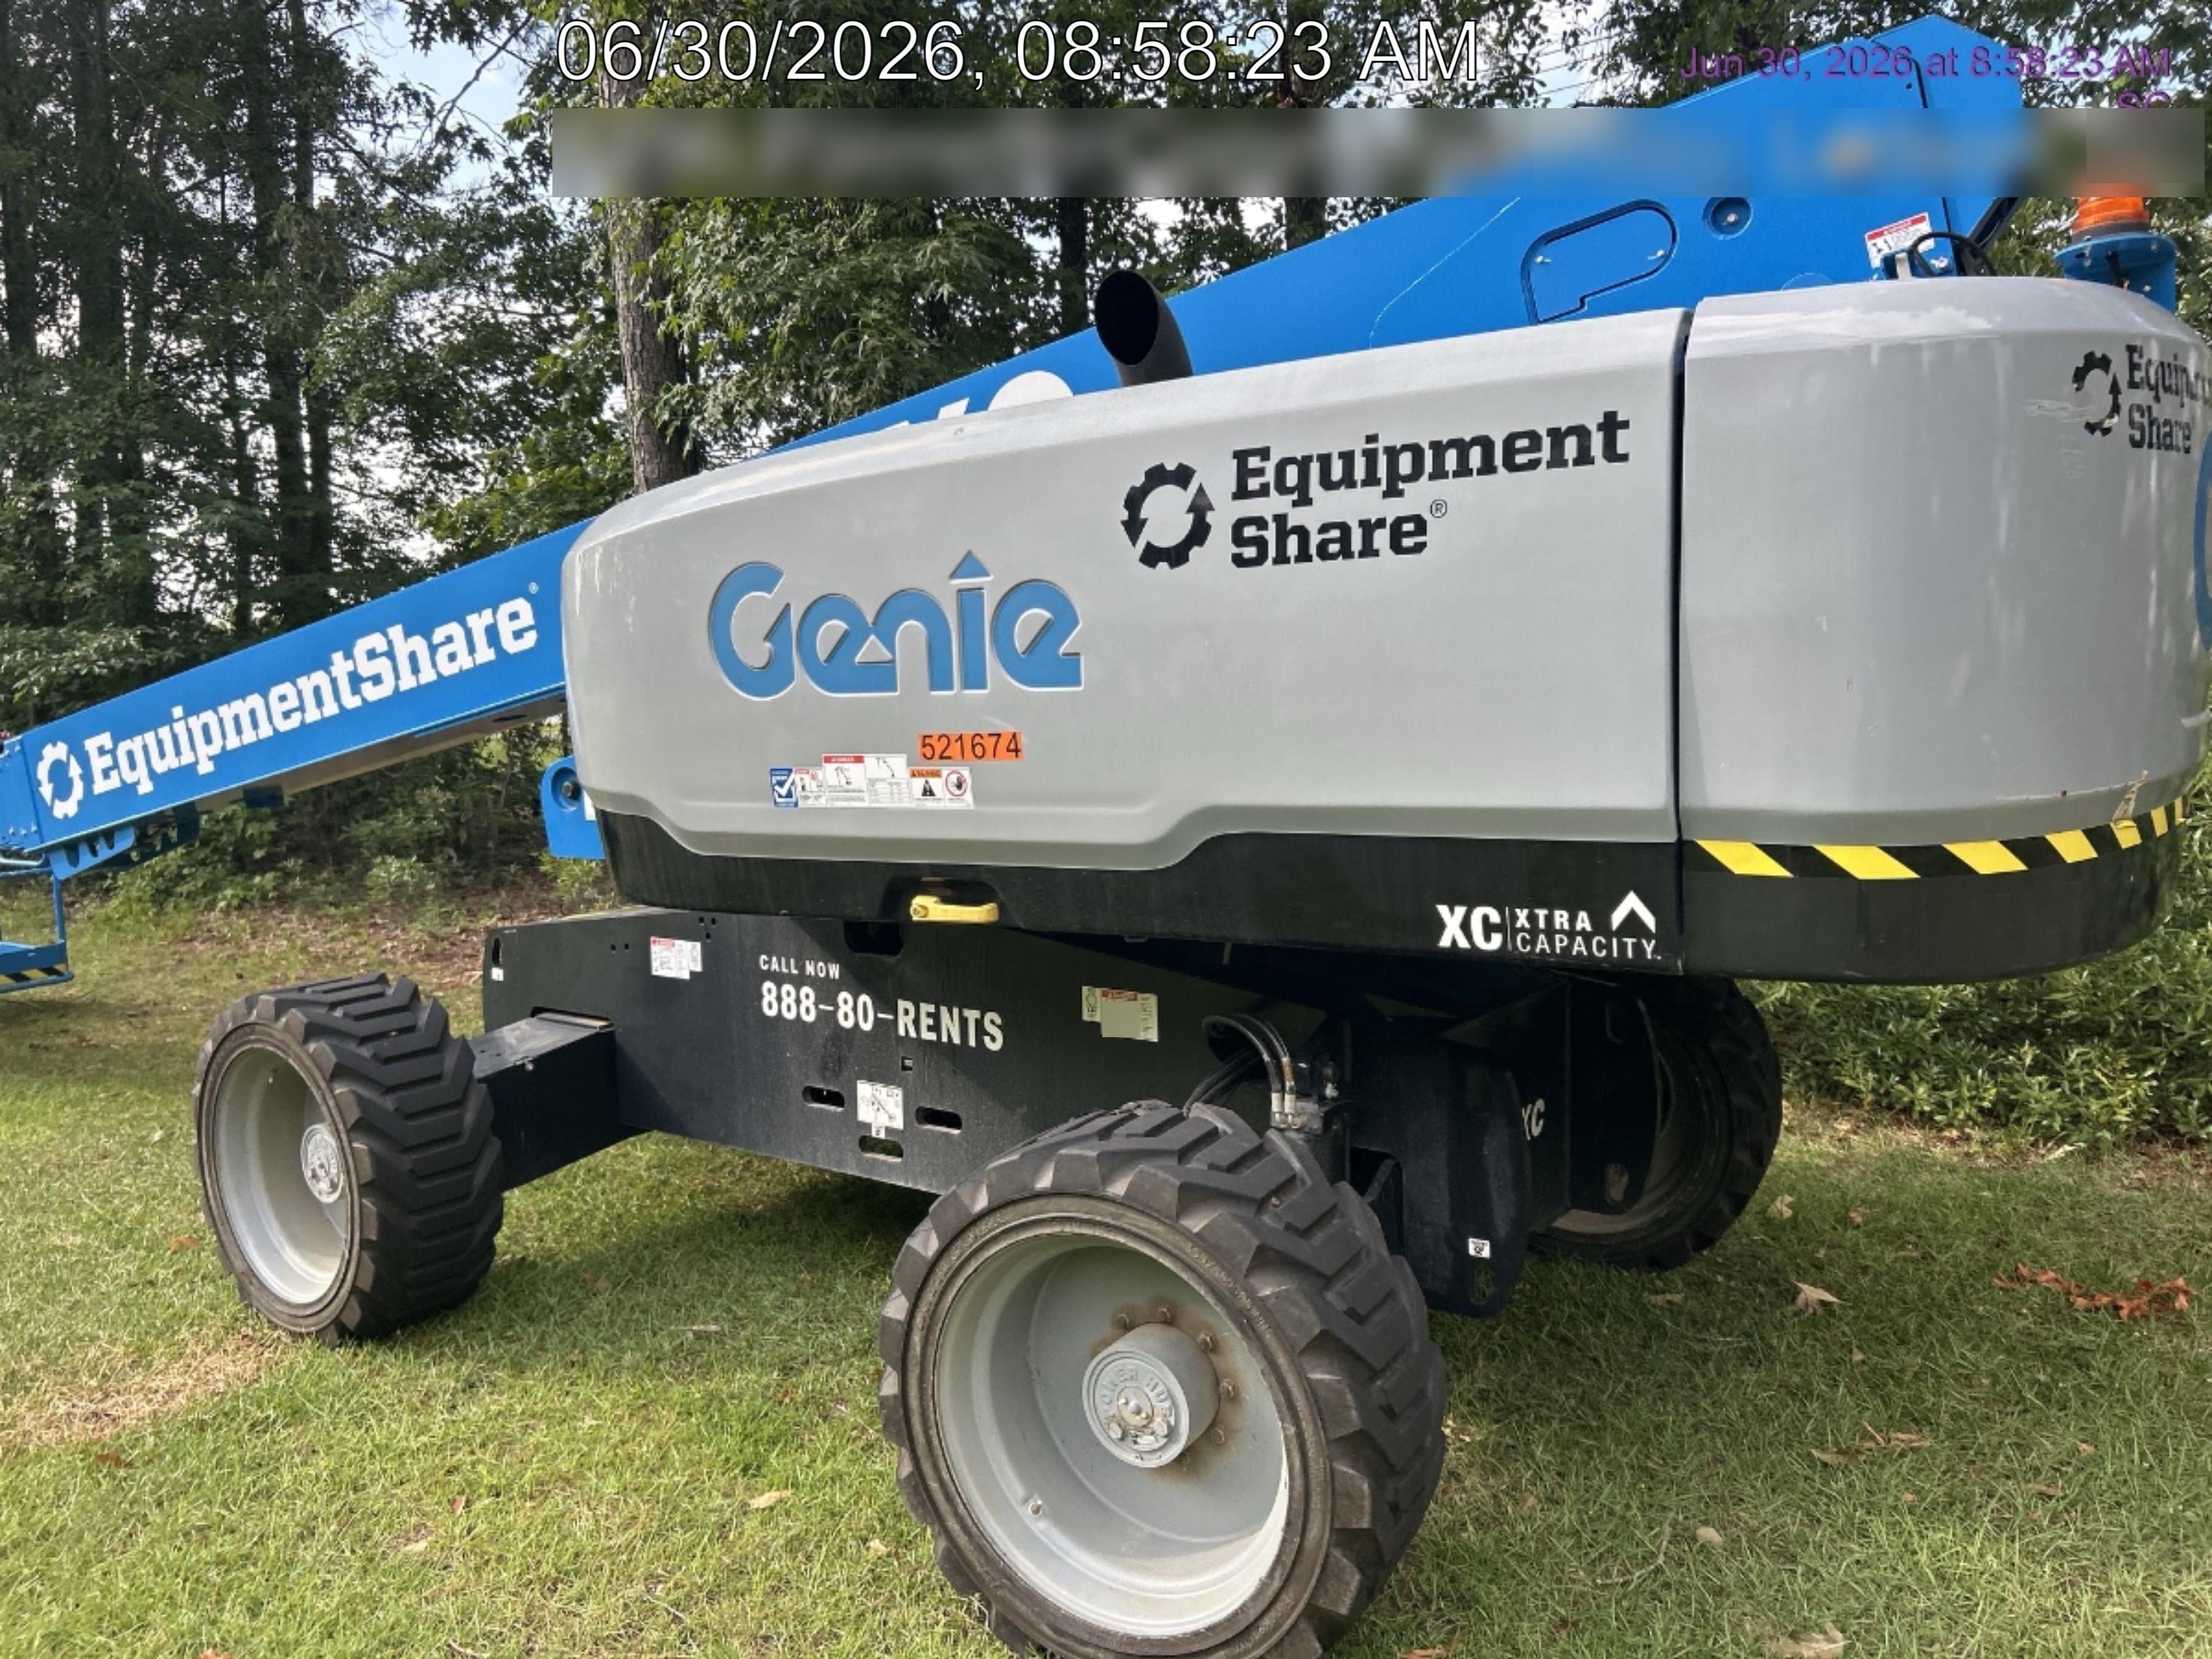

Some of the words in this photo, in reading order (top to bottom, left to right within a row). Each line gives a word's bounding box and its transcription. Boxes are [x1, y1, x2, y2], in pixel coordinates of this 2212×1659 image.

[2128, 403, 2191, 454] Share
[1231, 410, 1630, 508] Equipment
[708, 550, 1085, 701] Genie
[921, 732, 1022, 761] 521674
[1435, 904, 1503, 951] XC
[1515, 908, 1593, 931] XTRA
[1516, 932, 1657, 960] CAPACITY
[759, 954, 799, 975] CALL
[804, 959, 841, 980] NOW
[761, 980, 1005, 1052] 888-80-RENTS
